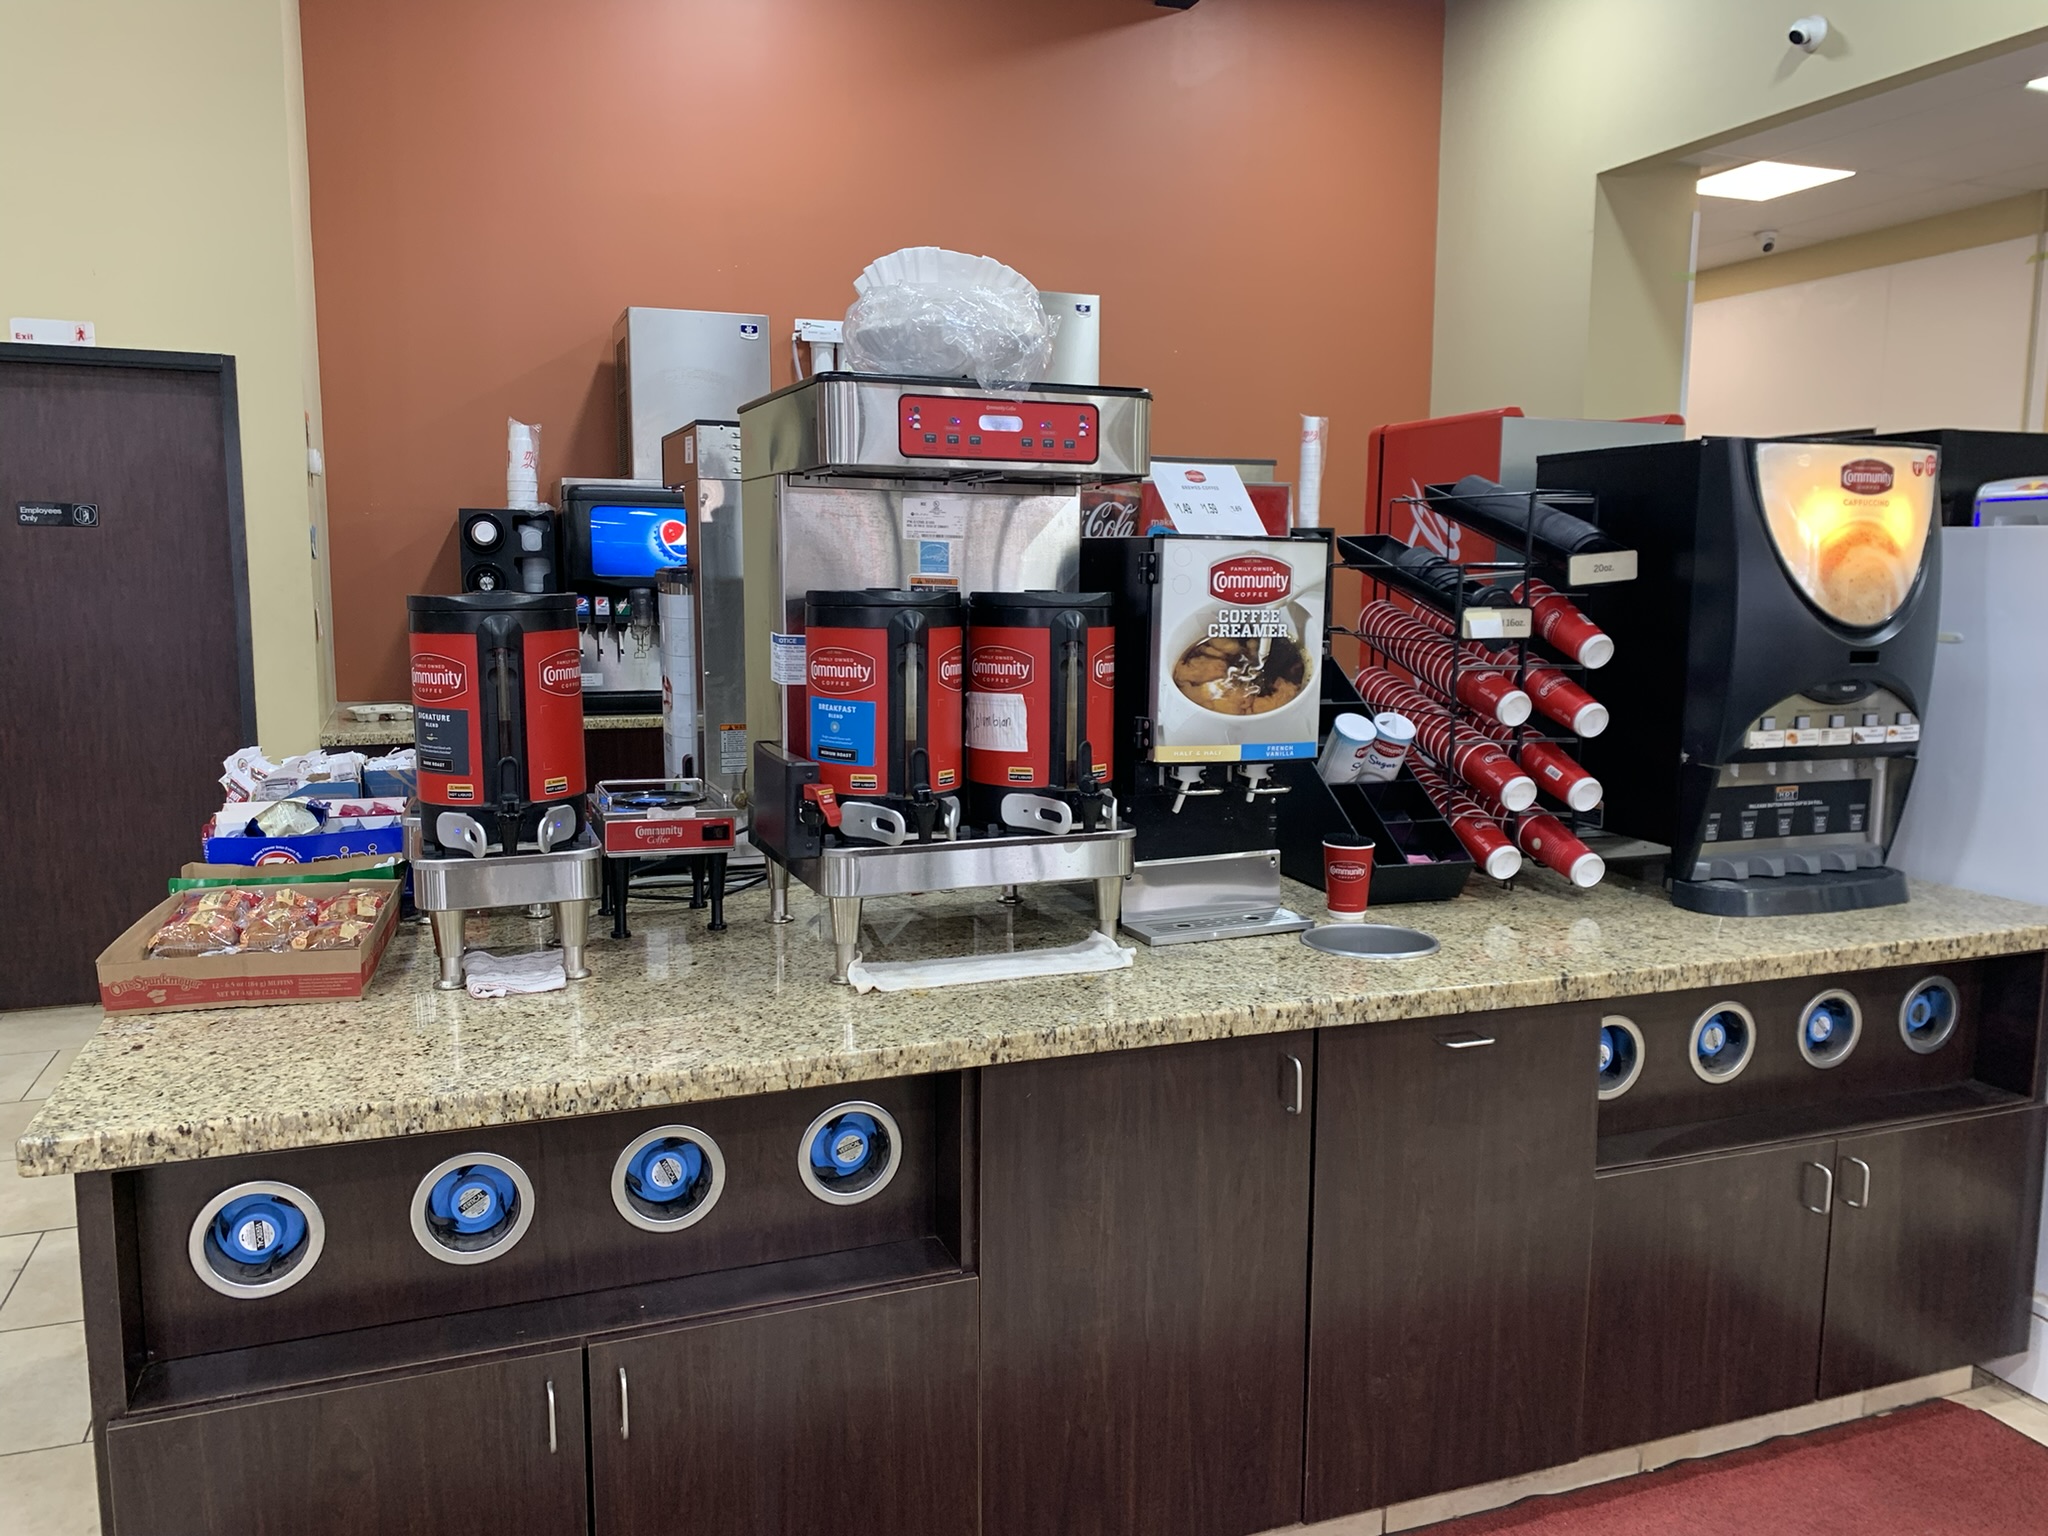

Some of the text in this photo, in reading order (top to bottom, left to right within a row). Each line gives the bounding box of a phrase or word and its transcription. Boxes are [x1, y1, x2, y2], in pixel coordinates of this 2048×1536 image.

[15, 332, 34, 340] Exit
[1843, 469, 1893, 487] Community
[1843, 499, 1890, 507] CAPPUCCINO
[20, 507, 62, 515] Employees
[20, 514, 38, 522] Only
[1593, 564, 1614, 573] 20oz.
[1213, 570, 1289, 592] Community
[1218, 609, 1280, 623] COFFEE
[1208, 623, 1288, 637] CREAMER
[811, 660, 871, 682] Community
[972, 659, 1030, 679] Community
[818, 703, 857, 714] BREAKFAST
[418, 711, 451, 722] SIGNATURE
[425, 721, 439, 729] BLEND
[1368, 753, 1397, 769] Sugar
[635, 825, 683, 839] Community
[646, 835, 671, 845] Coffee
